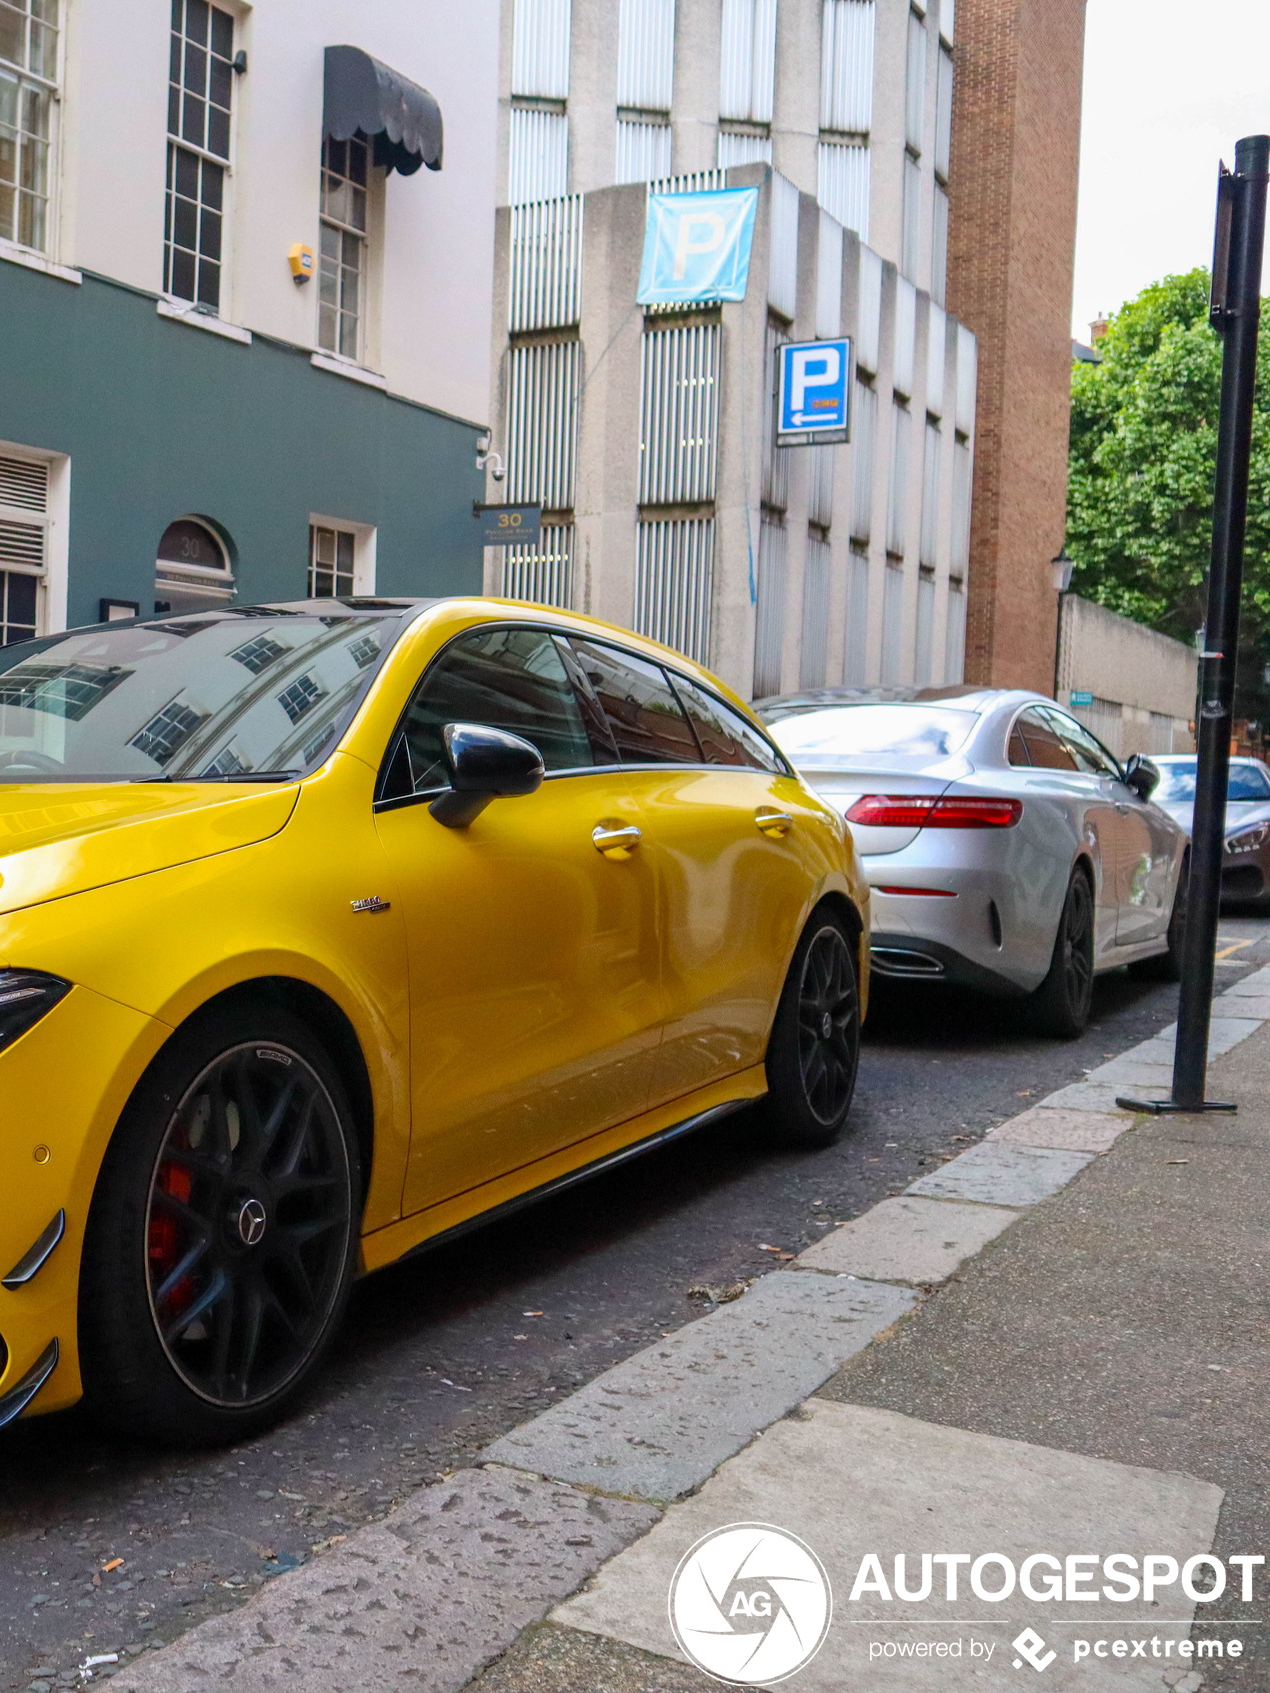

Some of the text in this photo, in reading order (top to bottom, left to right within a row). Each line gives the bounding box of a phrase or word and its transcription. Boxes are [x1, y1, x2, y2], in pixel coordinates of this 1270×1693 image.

[673, 212, 725, 280] P
[791, 347, 840, 411] P
[498, 513, 522, 527] 30
[181, 536, 200, 558] 30
